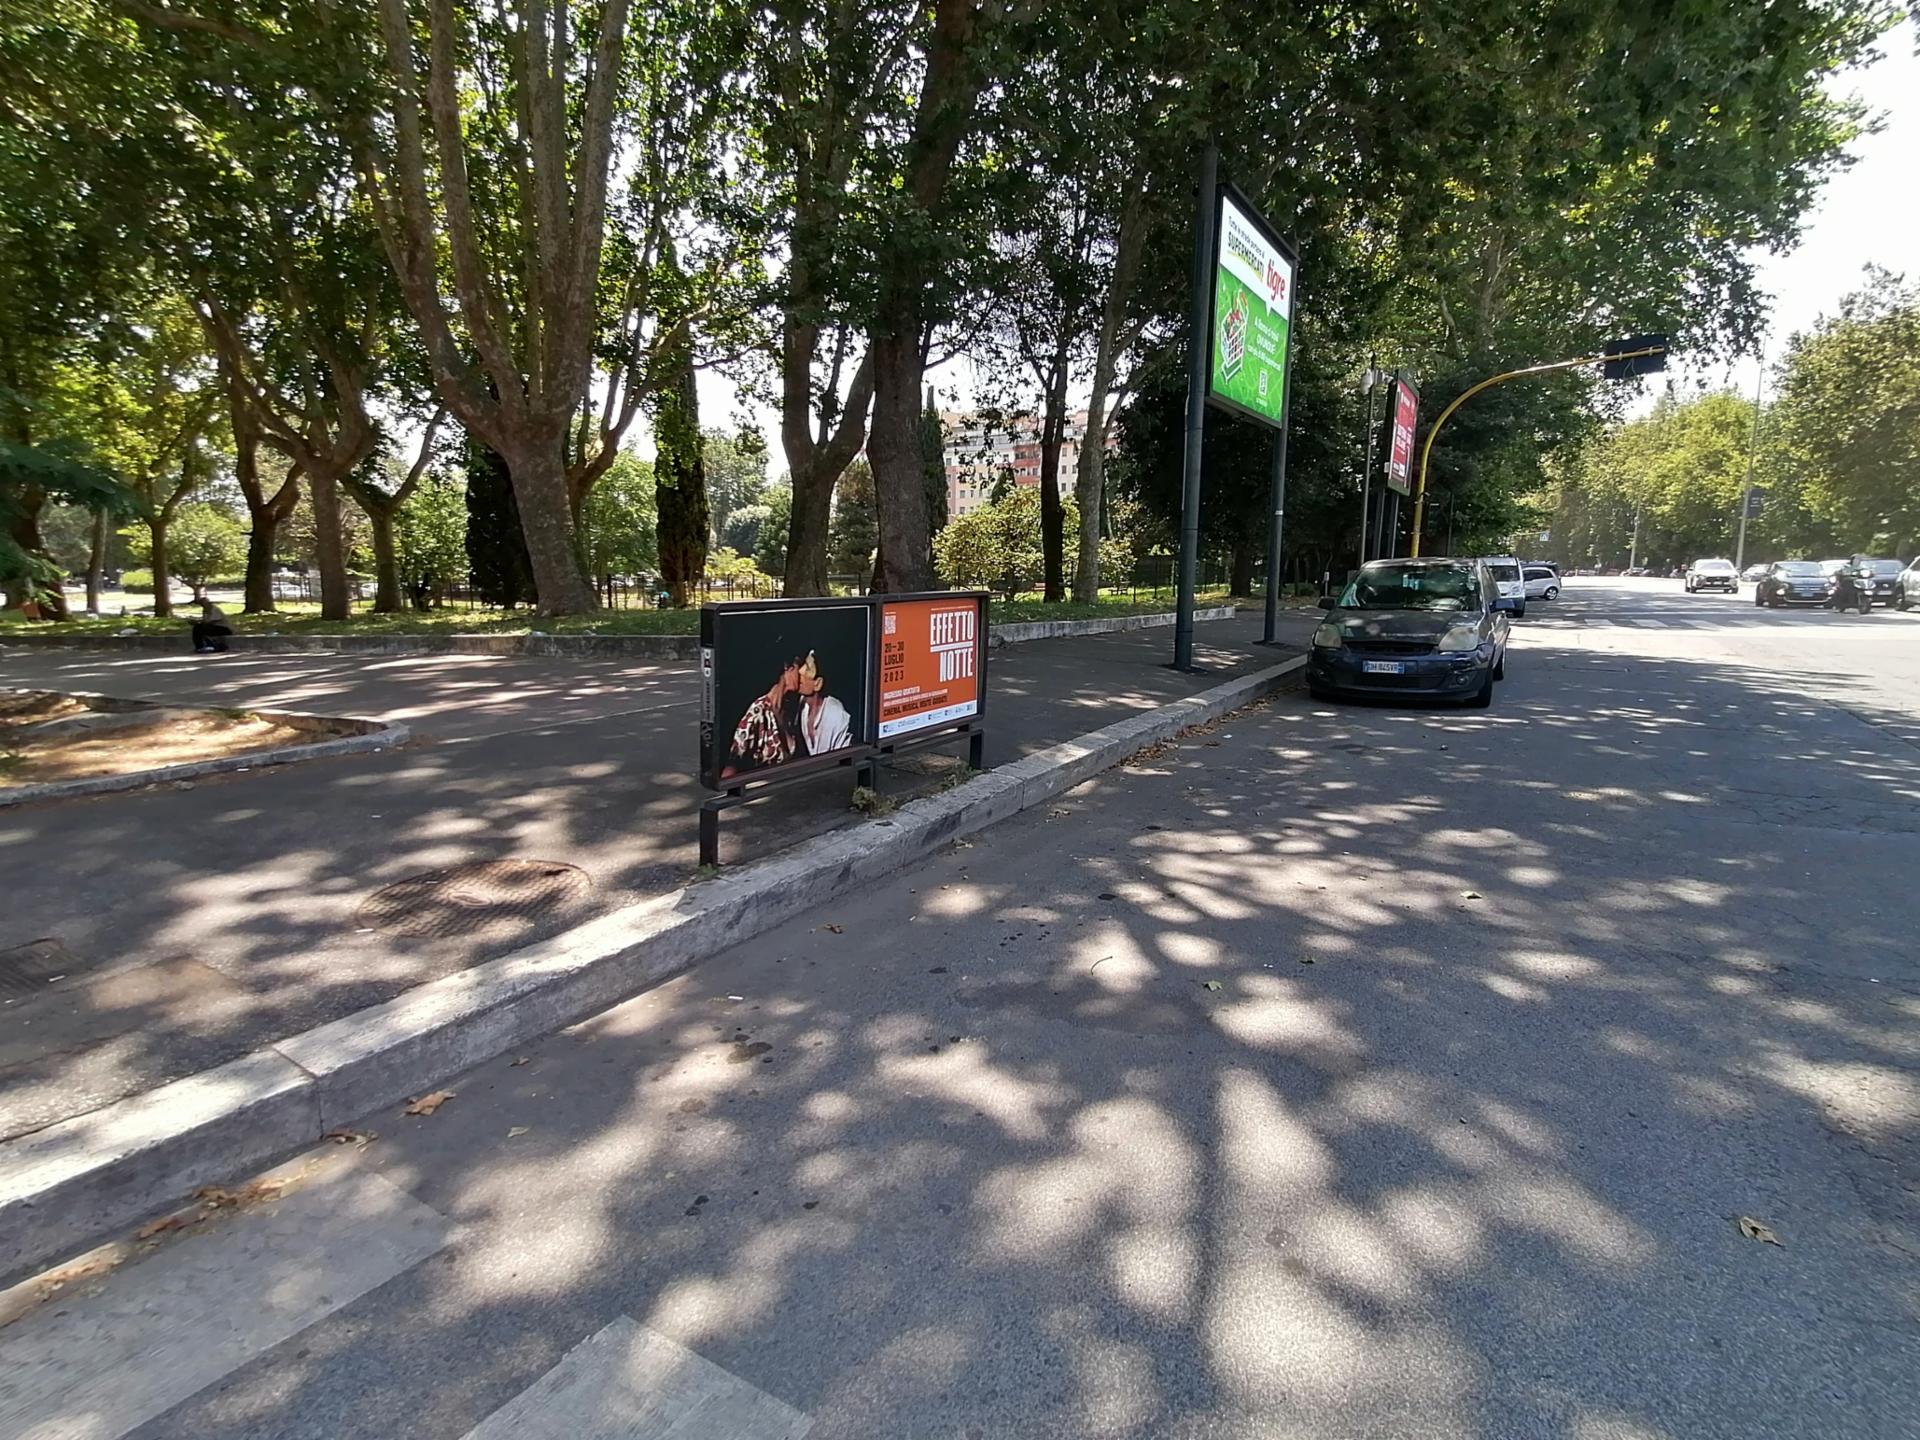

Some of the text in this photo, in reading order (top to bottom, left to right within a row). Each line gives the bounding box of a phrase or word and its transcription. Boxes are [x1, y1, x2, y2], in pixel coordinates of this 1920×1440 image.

[1228, 231, 1265, 279] SUPERMERCATI
[1266, 258, 1286, 301] tigre
[930, 610, 974, 645] EFFETTO
[884, 653, 904, 666] LUGLIO
[884, 671, 904, 683] 2023
[940, 647, 974, 682] NOTTE
